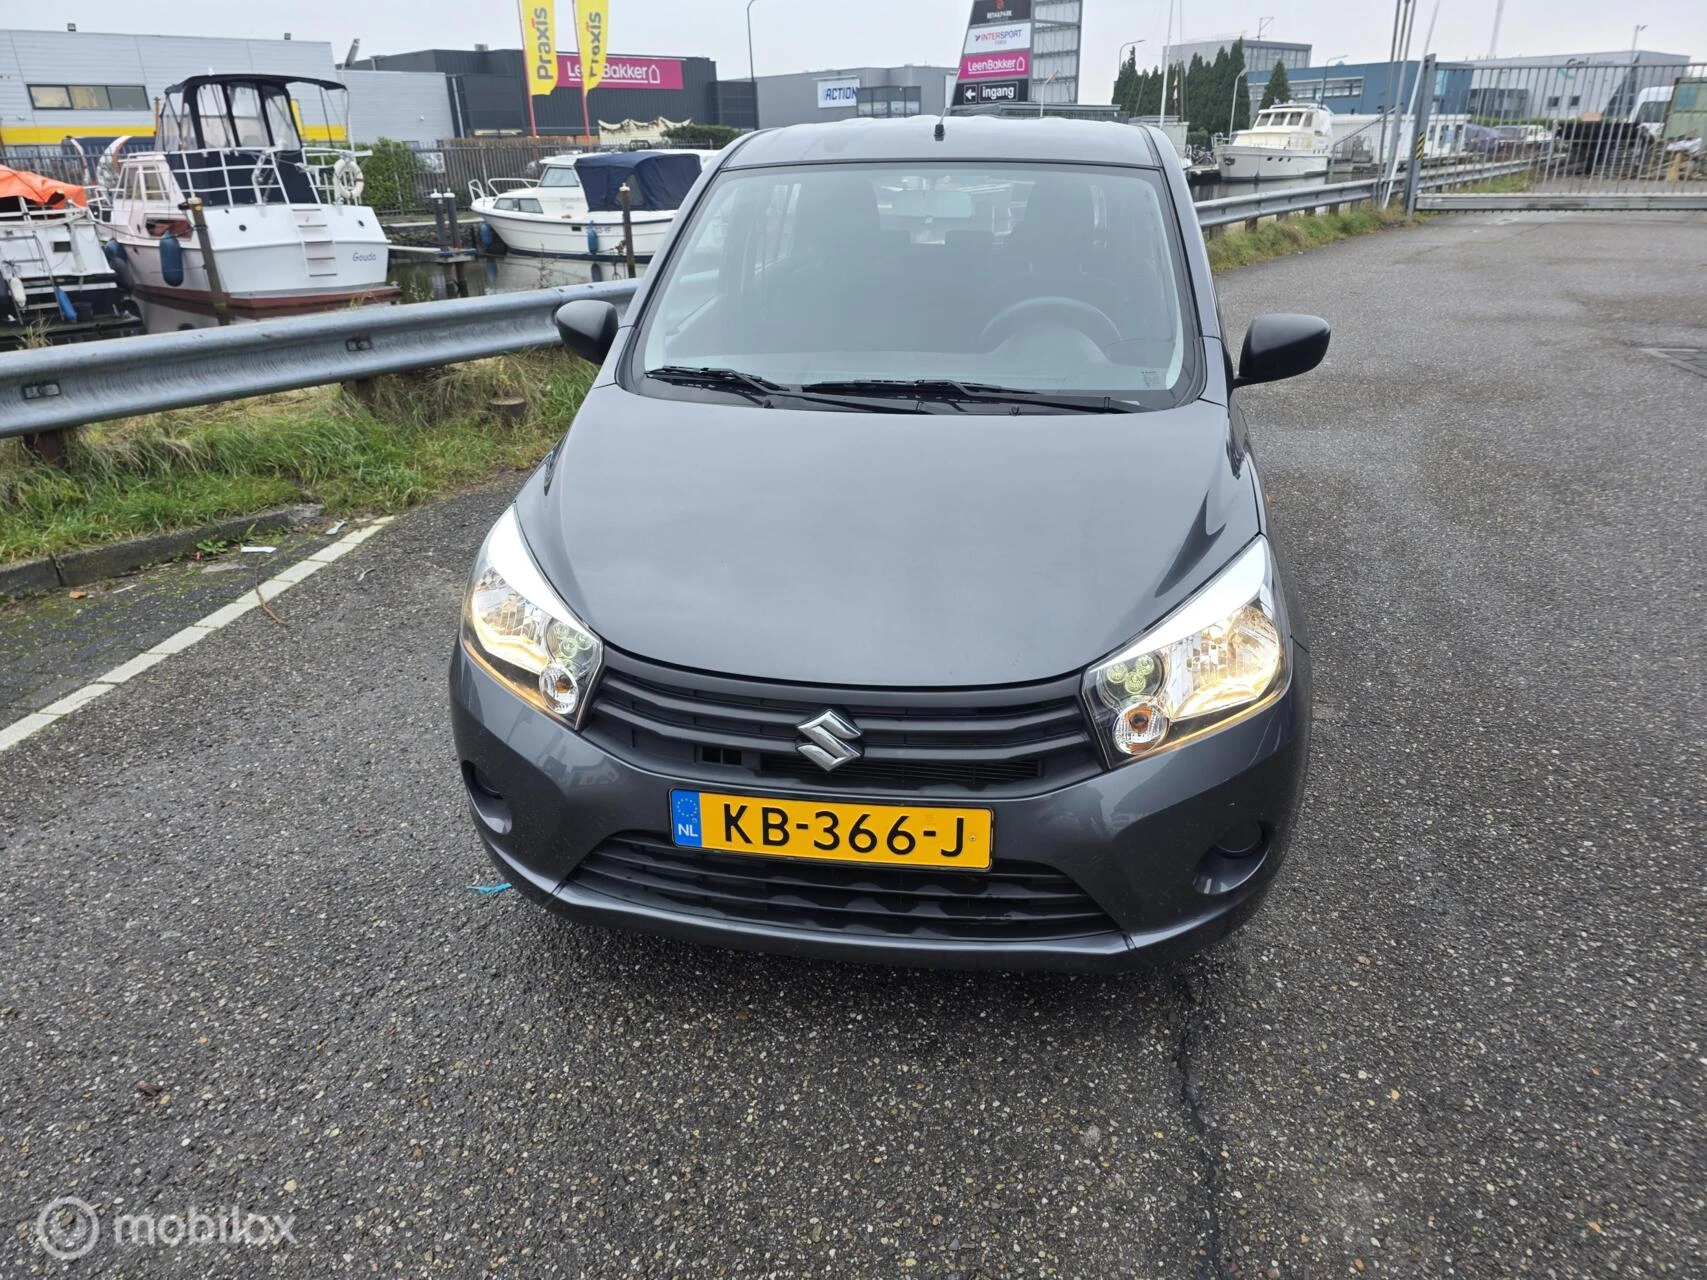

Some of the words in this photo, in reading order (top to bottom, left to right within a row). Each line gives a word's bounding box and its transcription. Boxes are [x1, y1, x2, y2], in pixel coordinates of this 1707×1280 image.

[980, 29, 1022, 41] INTERSPORT
[531, 7, 554, 80] Praxis
[567, 61, 648, 79] LeBakker
[968, 58, 1017, 72] LeenBakker
[825, 86, 858, 101] ACTION
[982, 86, 1015, 99] ingang
[677, 822, 699, 838] NL
[722, 802, 965, 858] KB-366-J
